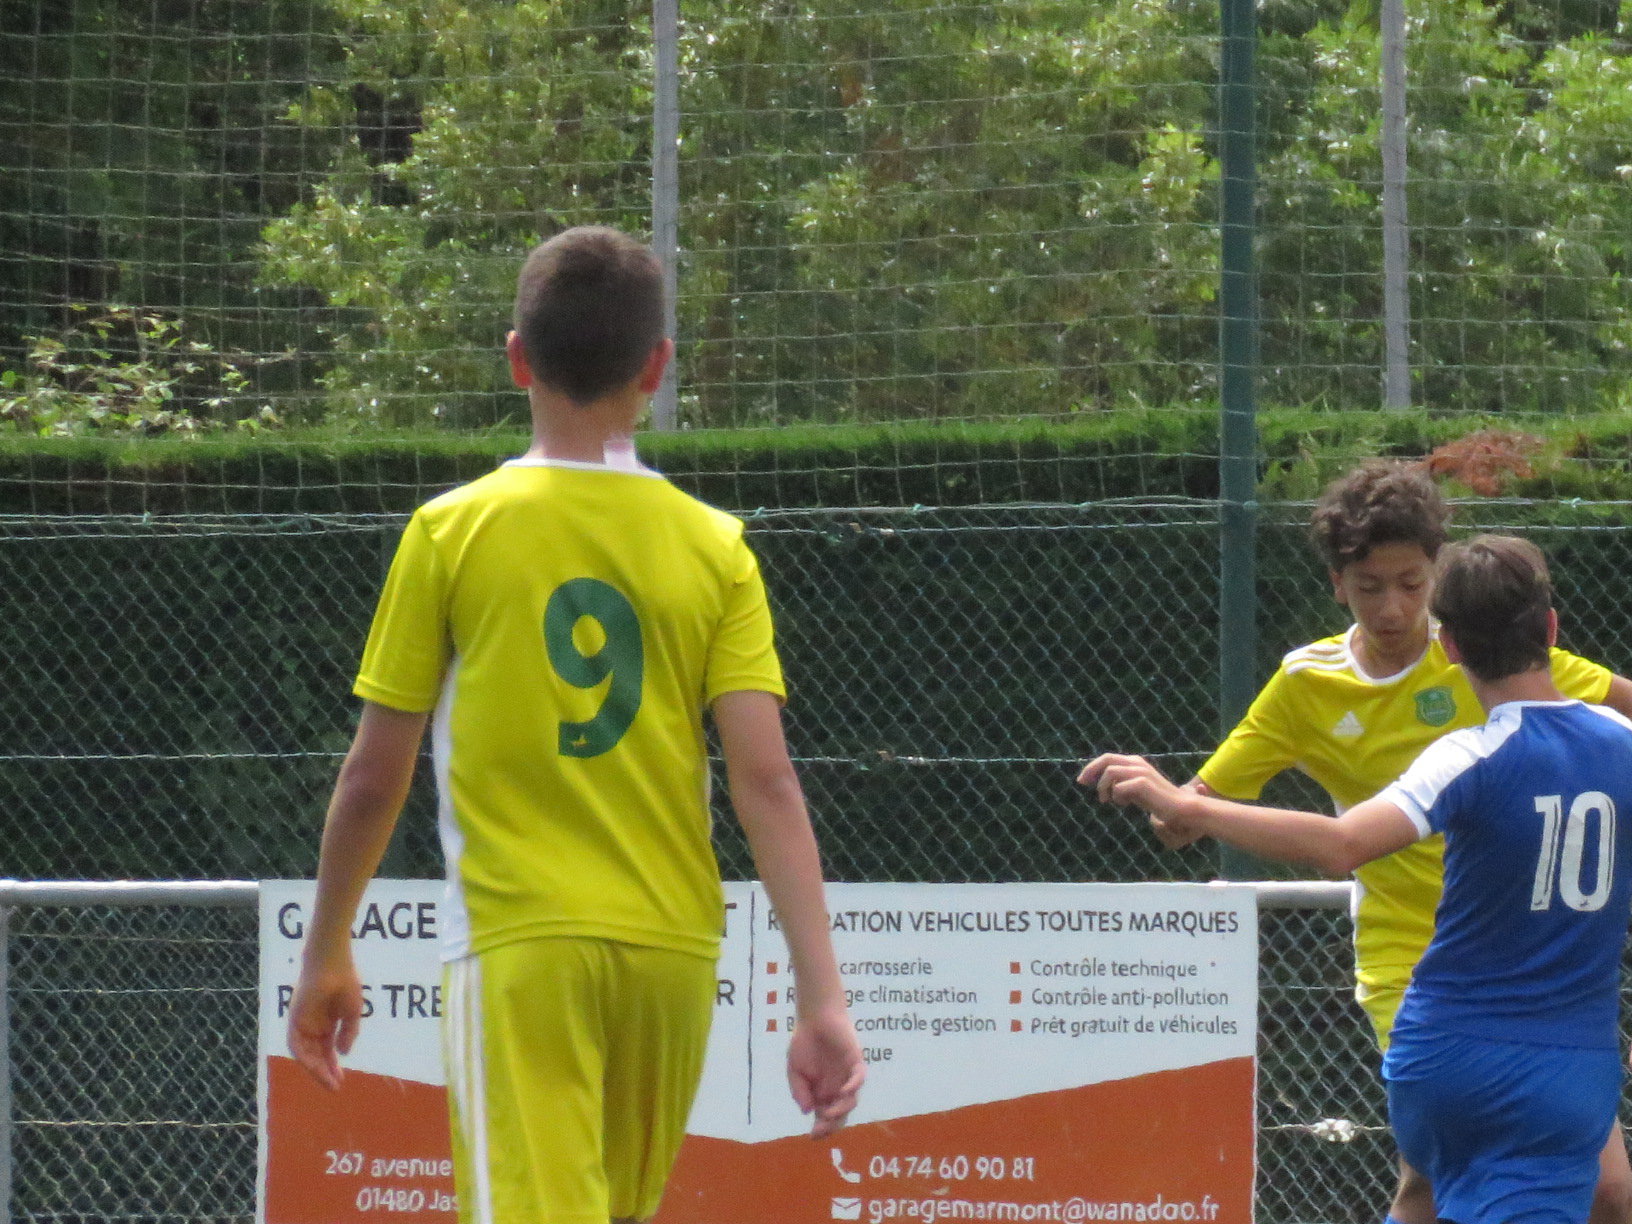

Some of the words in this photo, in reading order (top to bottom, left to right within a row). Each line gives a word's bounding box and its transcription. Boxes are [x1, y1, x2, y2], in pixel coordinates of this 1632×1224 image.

[543, 577, 644, 758] 9
[1530, 790, 1616, 911] 10
[278, 902, 437, 939] GAGE
[909, 911, 1030, 932] VEHICULES
[1039, 911, 1123, 932] TOUTES
[1129, 911, 1239, 937] MARQUES
[839, 960, 933, 975] carrosserie
[1031, 958, 1106, 977] Contrôle
[1111, 961, 1197, 980] technique
[868, 986, 977, 1004] climatisation
[1032, 988, 1107, 1006] Contrôle
[1111, 989, 1229, 1009] anti-pollution
[855, 1014, 928, 1031] contrôle
[932, 1016, 996, 1036] gestion
[1031, 1017, 1065, 1034] Prêt
[1071, 1018, 1128, 1037] gratuit
[1134, 1018, 1154, 1033] de
[1159, 1016, 1237, 1035] véhicules
[325, 1150, 364, 1176] 267
[371, 1158, 452, 1178] avenue
[869, 1156, 900, 1179] 04
[905, 1156, 933, 1178] 74
[939, 1156, 969, 1180] 60
[975, 1156, 1004, 1180] 90
[1012, 1157, 1035, 1181] 81
[355, 1187, 426, 1212] 01480
